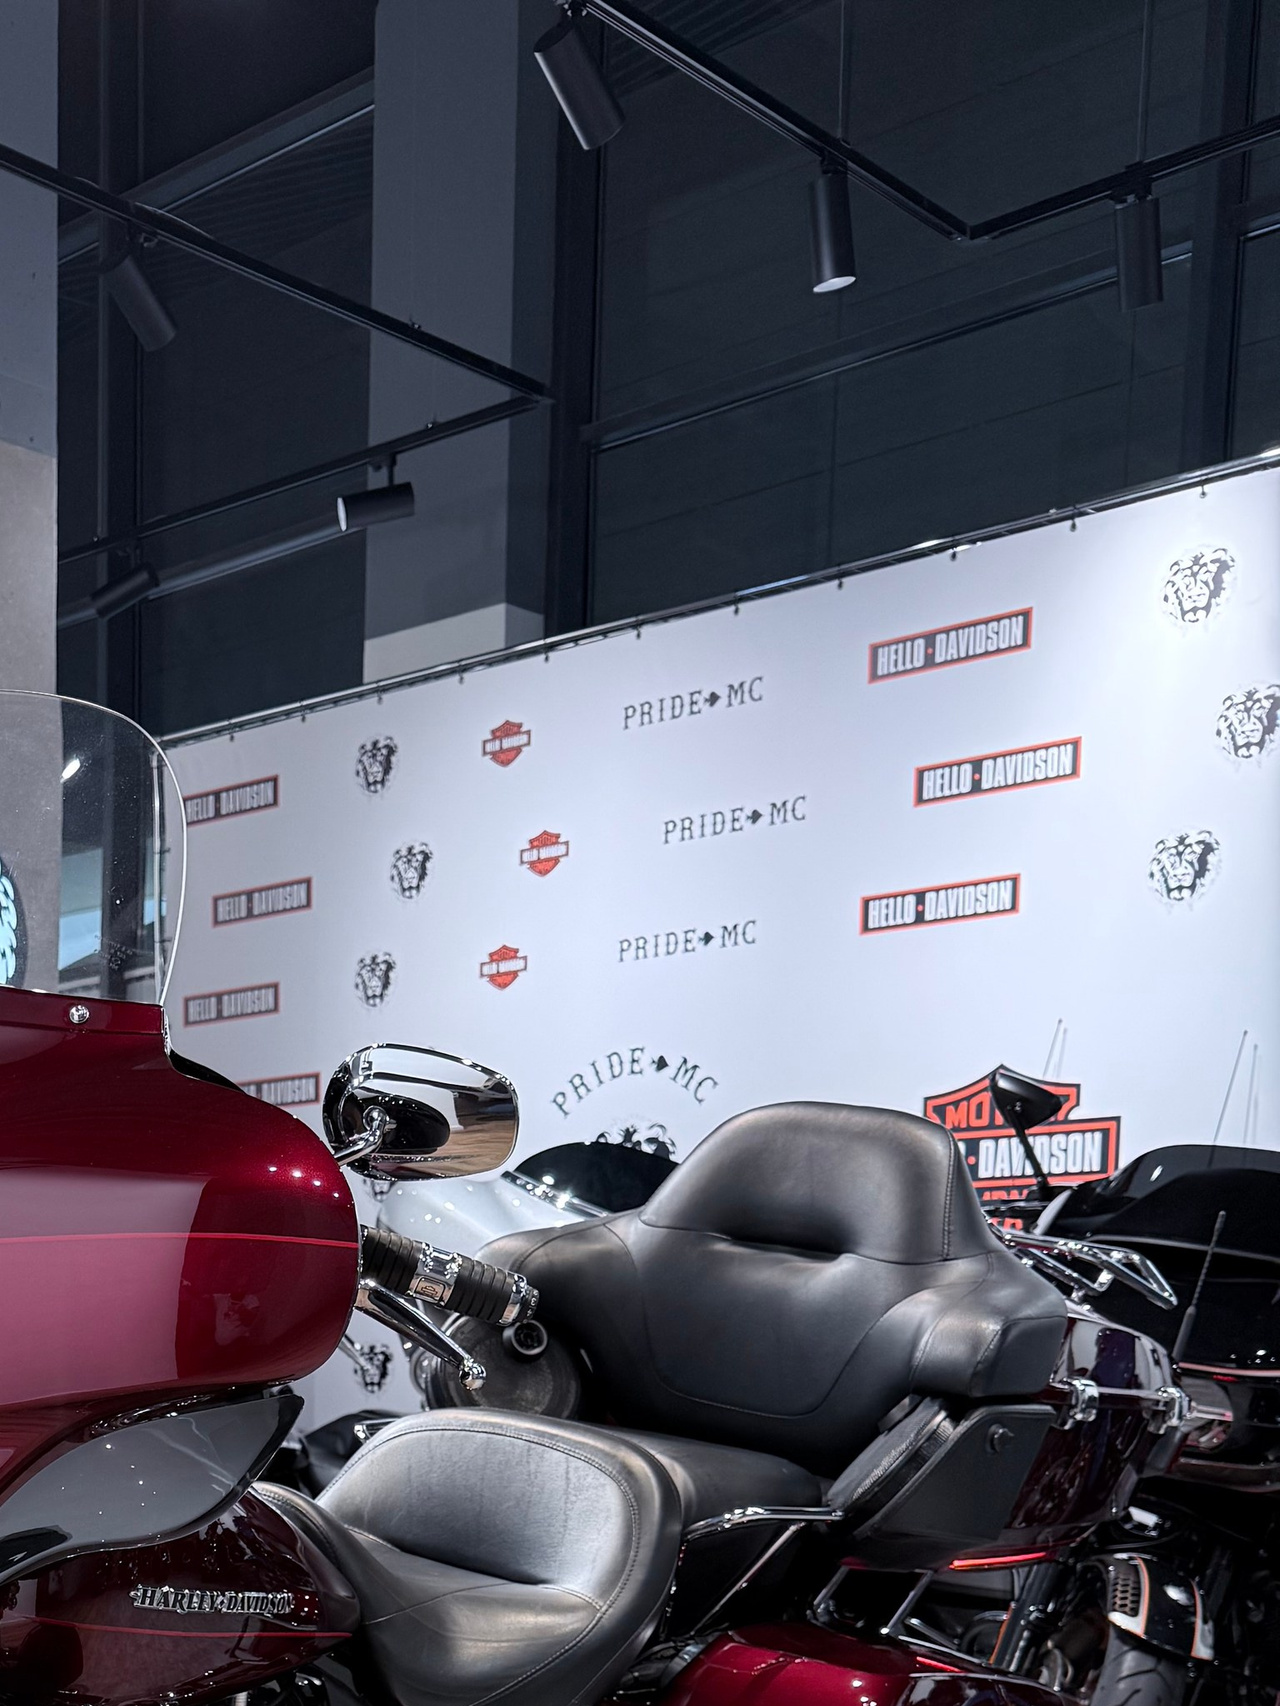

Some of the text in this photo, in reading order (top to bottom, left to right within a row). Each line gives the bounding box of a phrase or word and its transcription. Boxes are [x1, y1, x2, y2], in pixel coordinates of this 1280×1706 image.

[877, 614, 1024, 677] HELLO DAVIDSON
[623, 676, 764, 730] PRIDE MC
[922, 743, 1073, 801] HELLO DAVIDSON
[663, 795, 807, 845] PRIDE MC
[868, 879, 1012, 929] HELLO DAVIDSON
[618, 920, 757, 963] PRIDE MC
[551, 1046, 719, 1119] PRIDE MC
